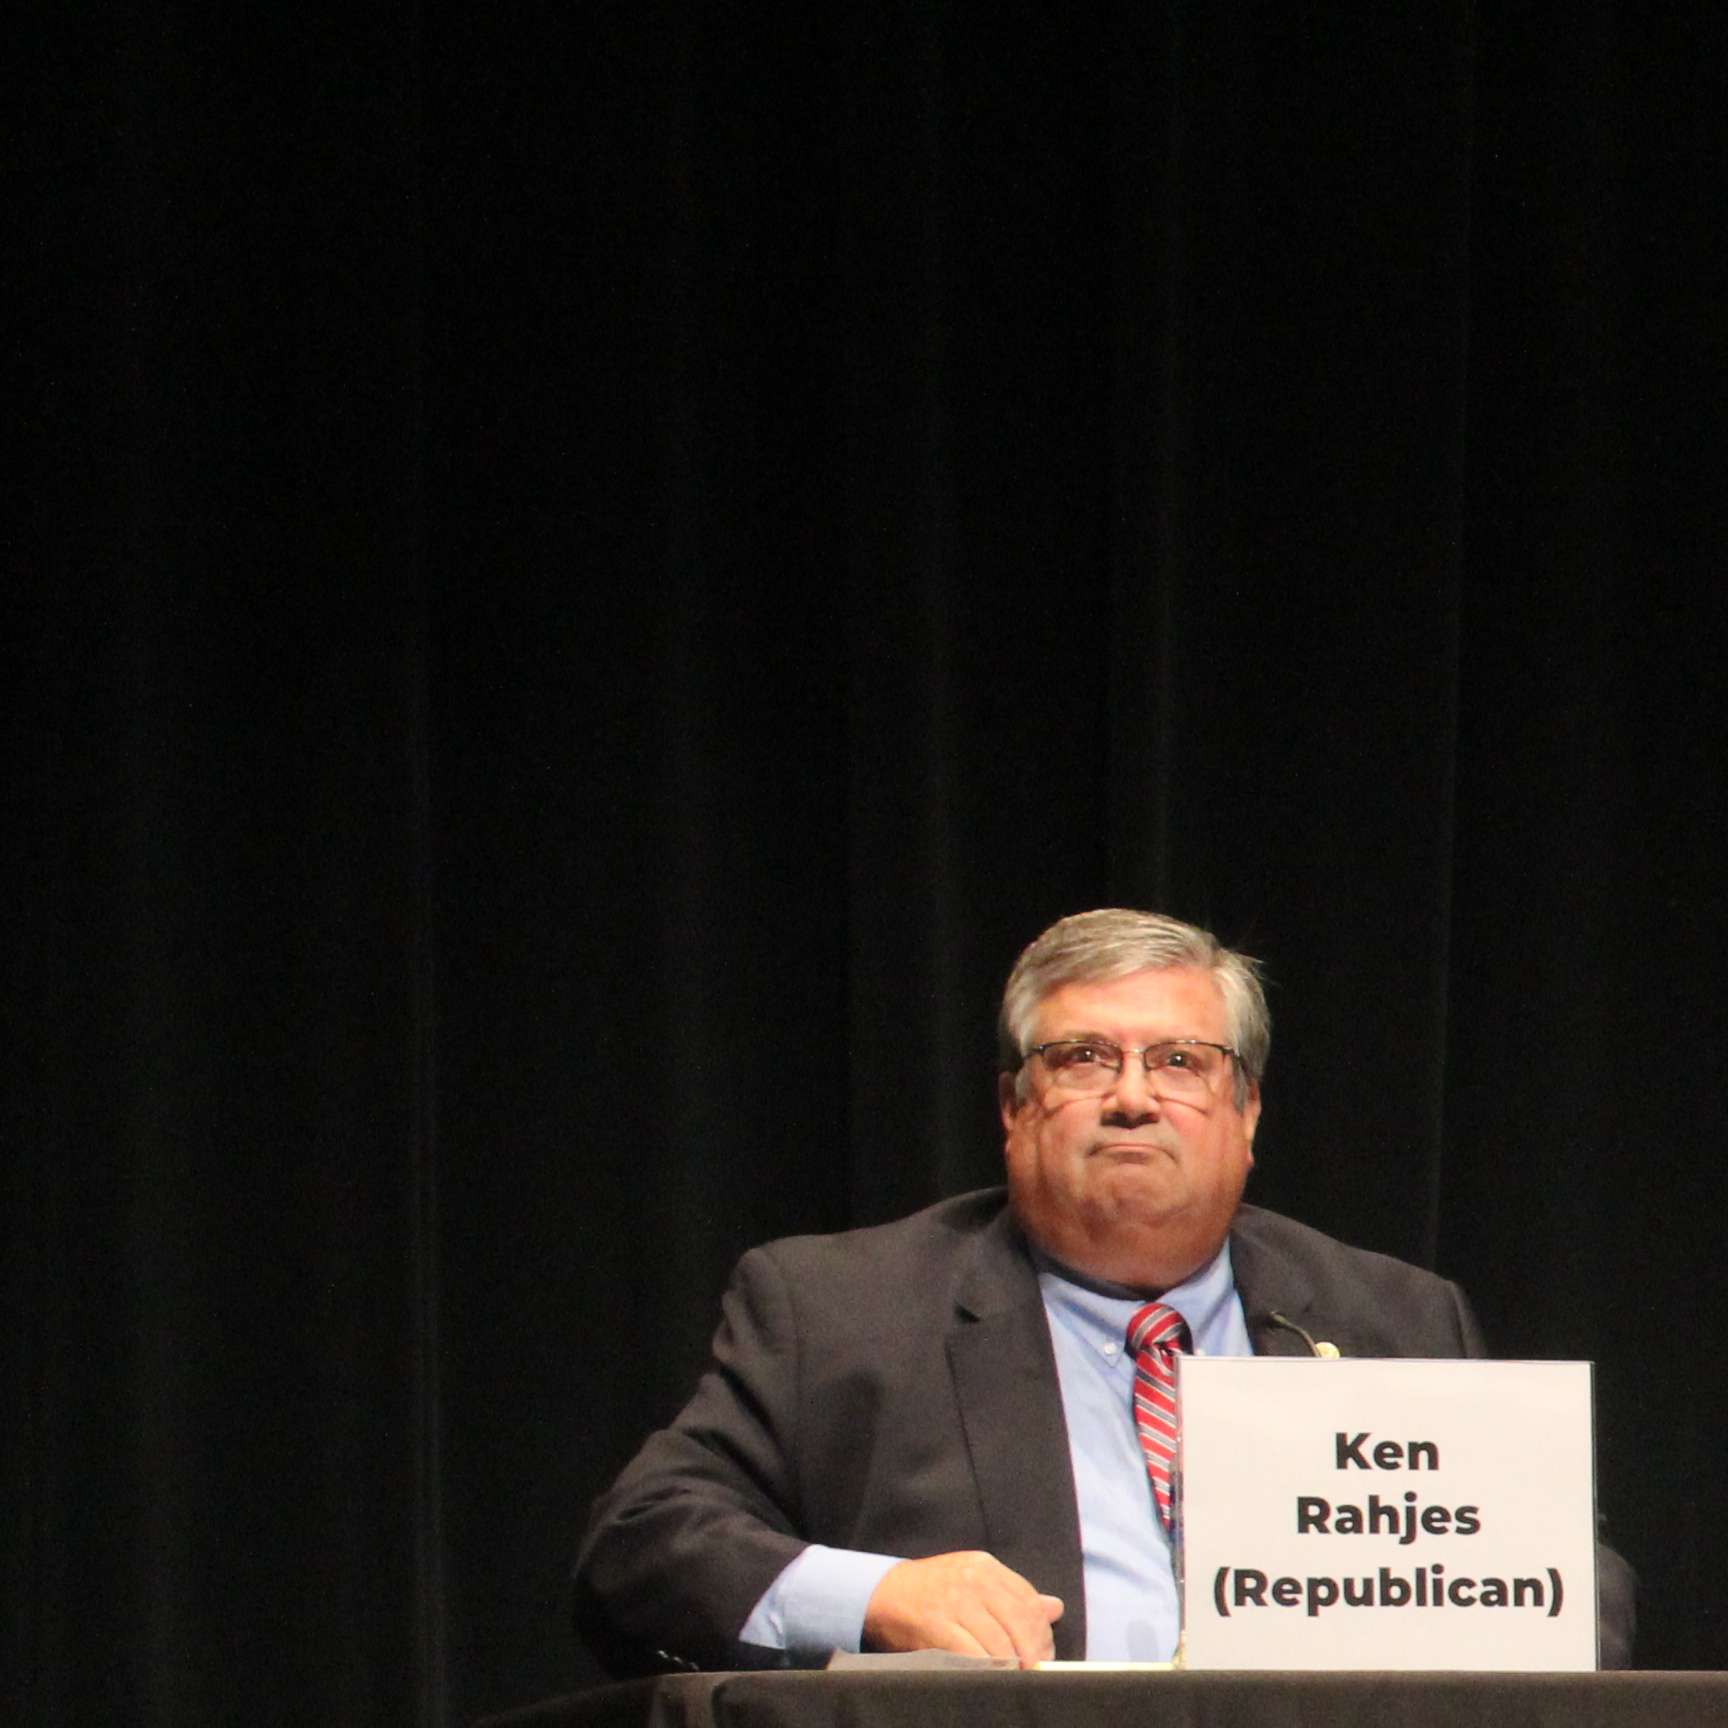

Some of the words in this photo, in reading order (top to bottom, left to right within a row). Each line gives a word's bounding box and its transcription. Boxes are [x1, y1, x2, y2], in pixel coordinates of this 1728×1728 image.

[1335, 1432, 1439, 1471] Ken
[1297, 1491, 1481, 1546] Rahjes
[1213, 1563, 1564, 1617] (Republican)
